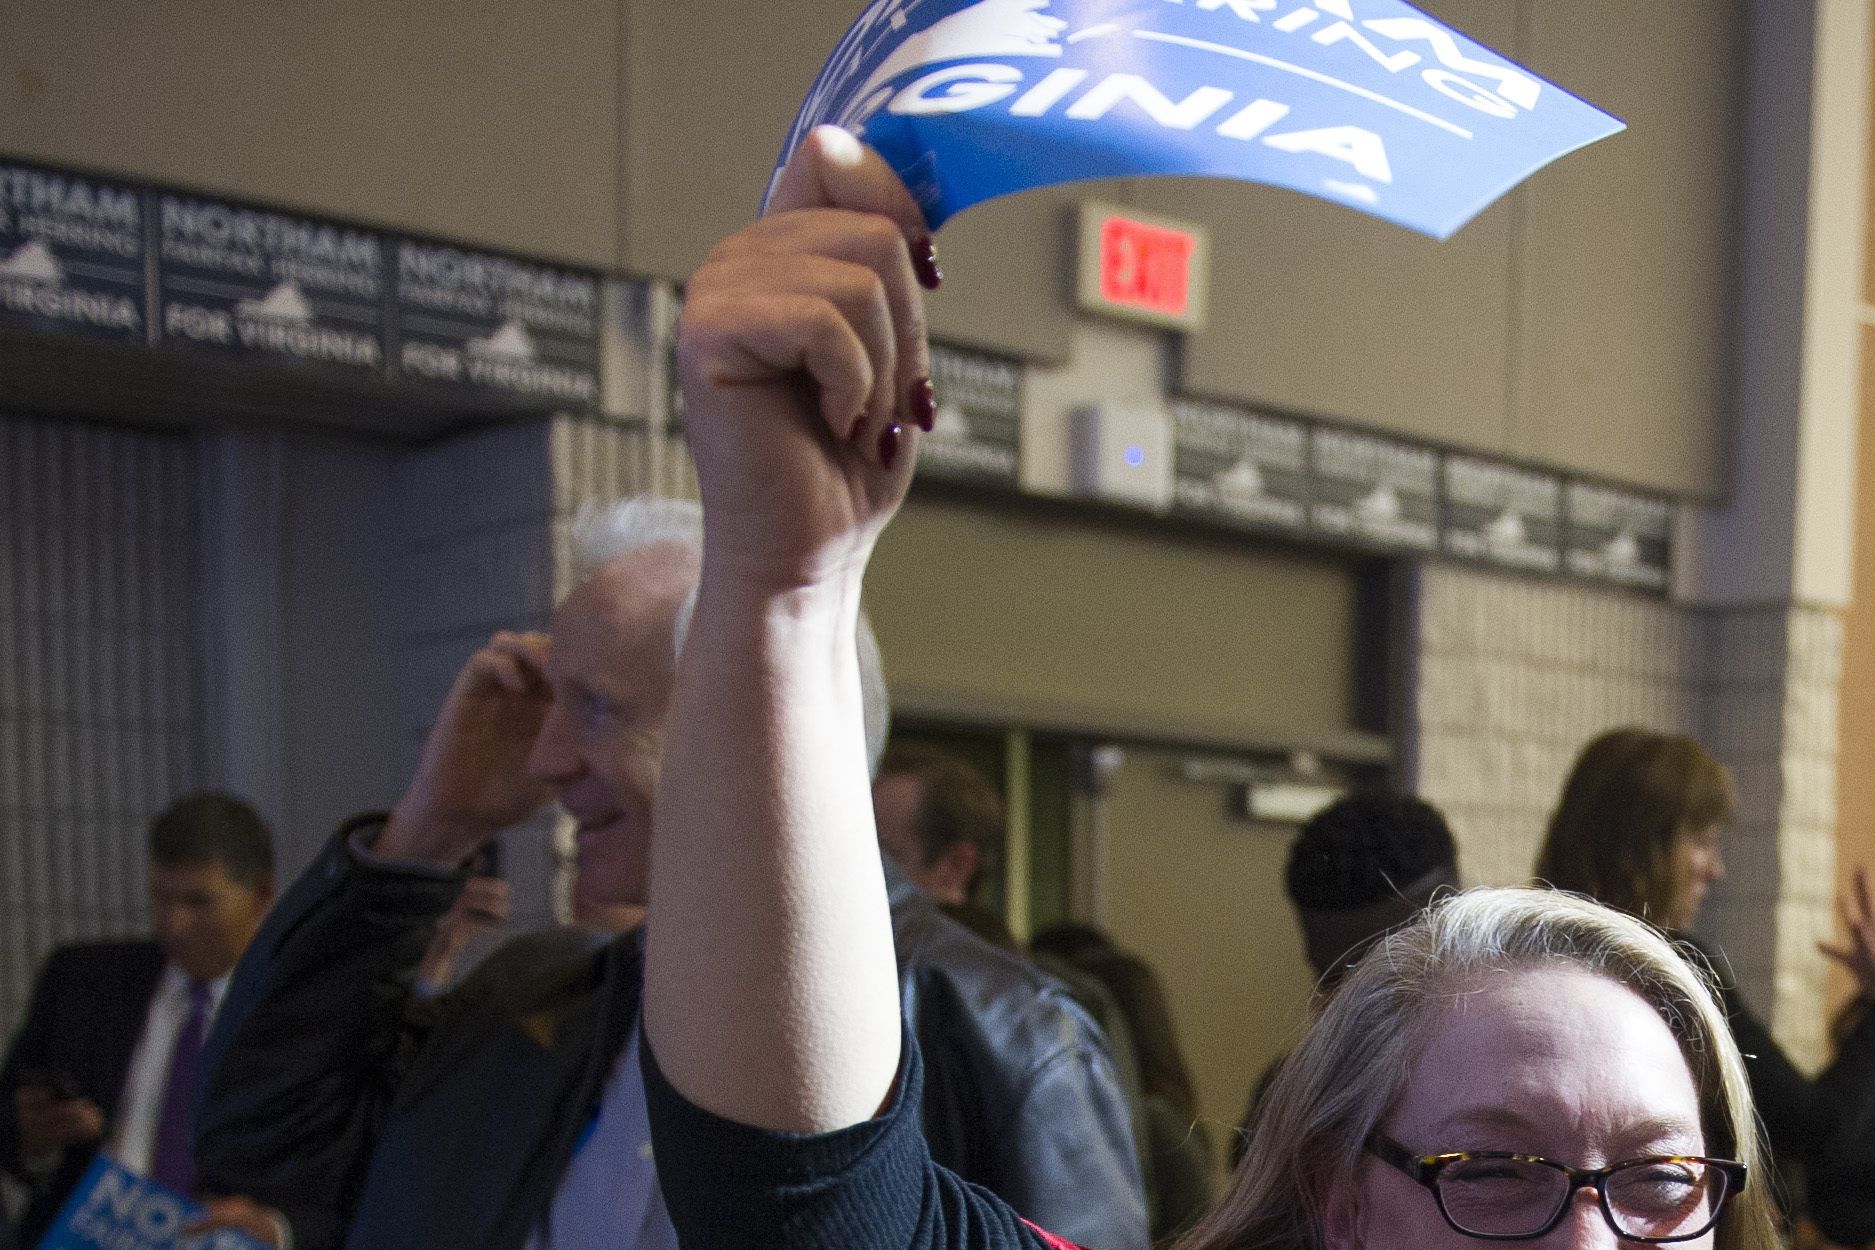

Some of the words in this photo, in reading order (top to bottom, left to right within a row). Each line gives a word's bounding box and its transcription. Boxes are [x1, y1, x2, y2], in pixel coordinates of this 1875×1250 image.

[161, 197, 382, 271] NORTHAM
[164, 302, 231, 345] FOR
[235, 322, 382, 367] VIRGINIA
